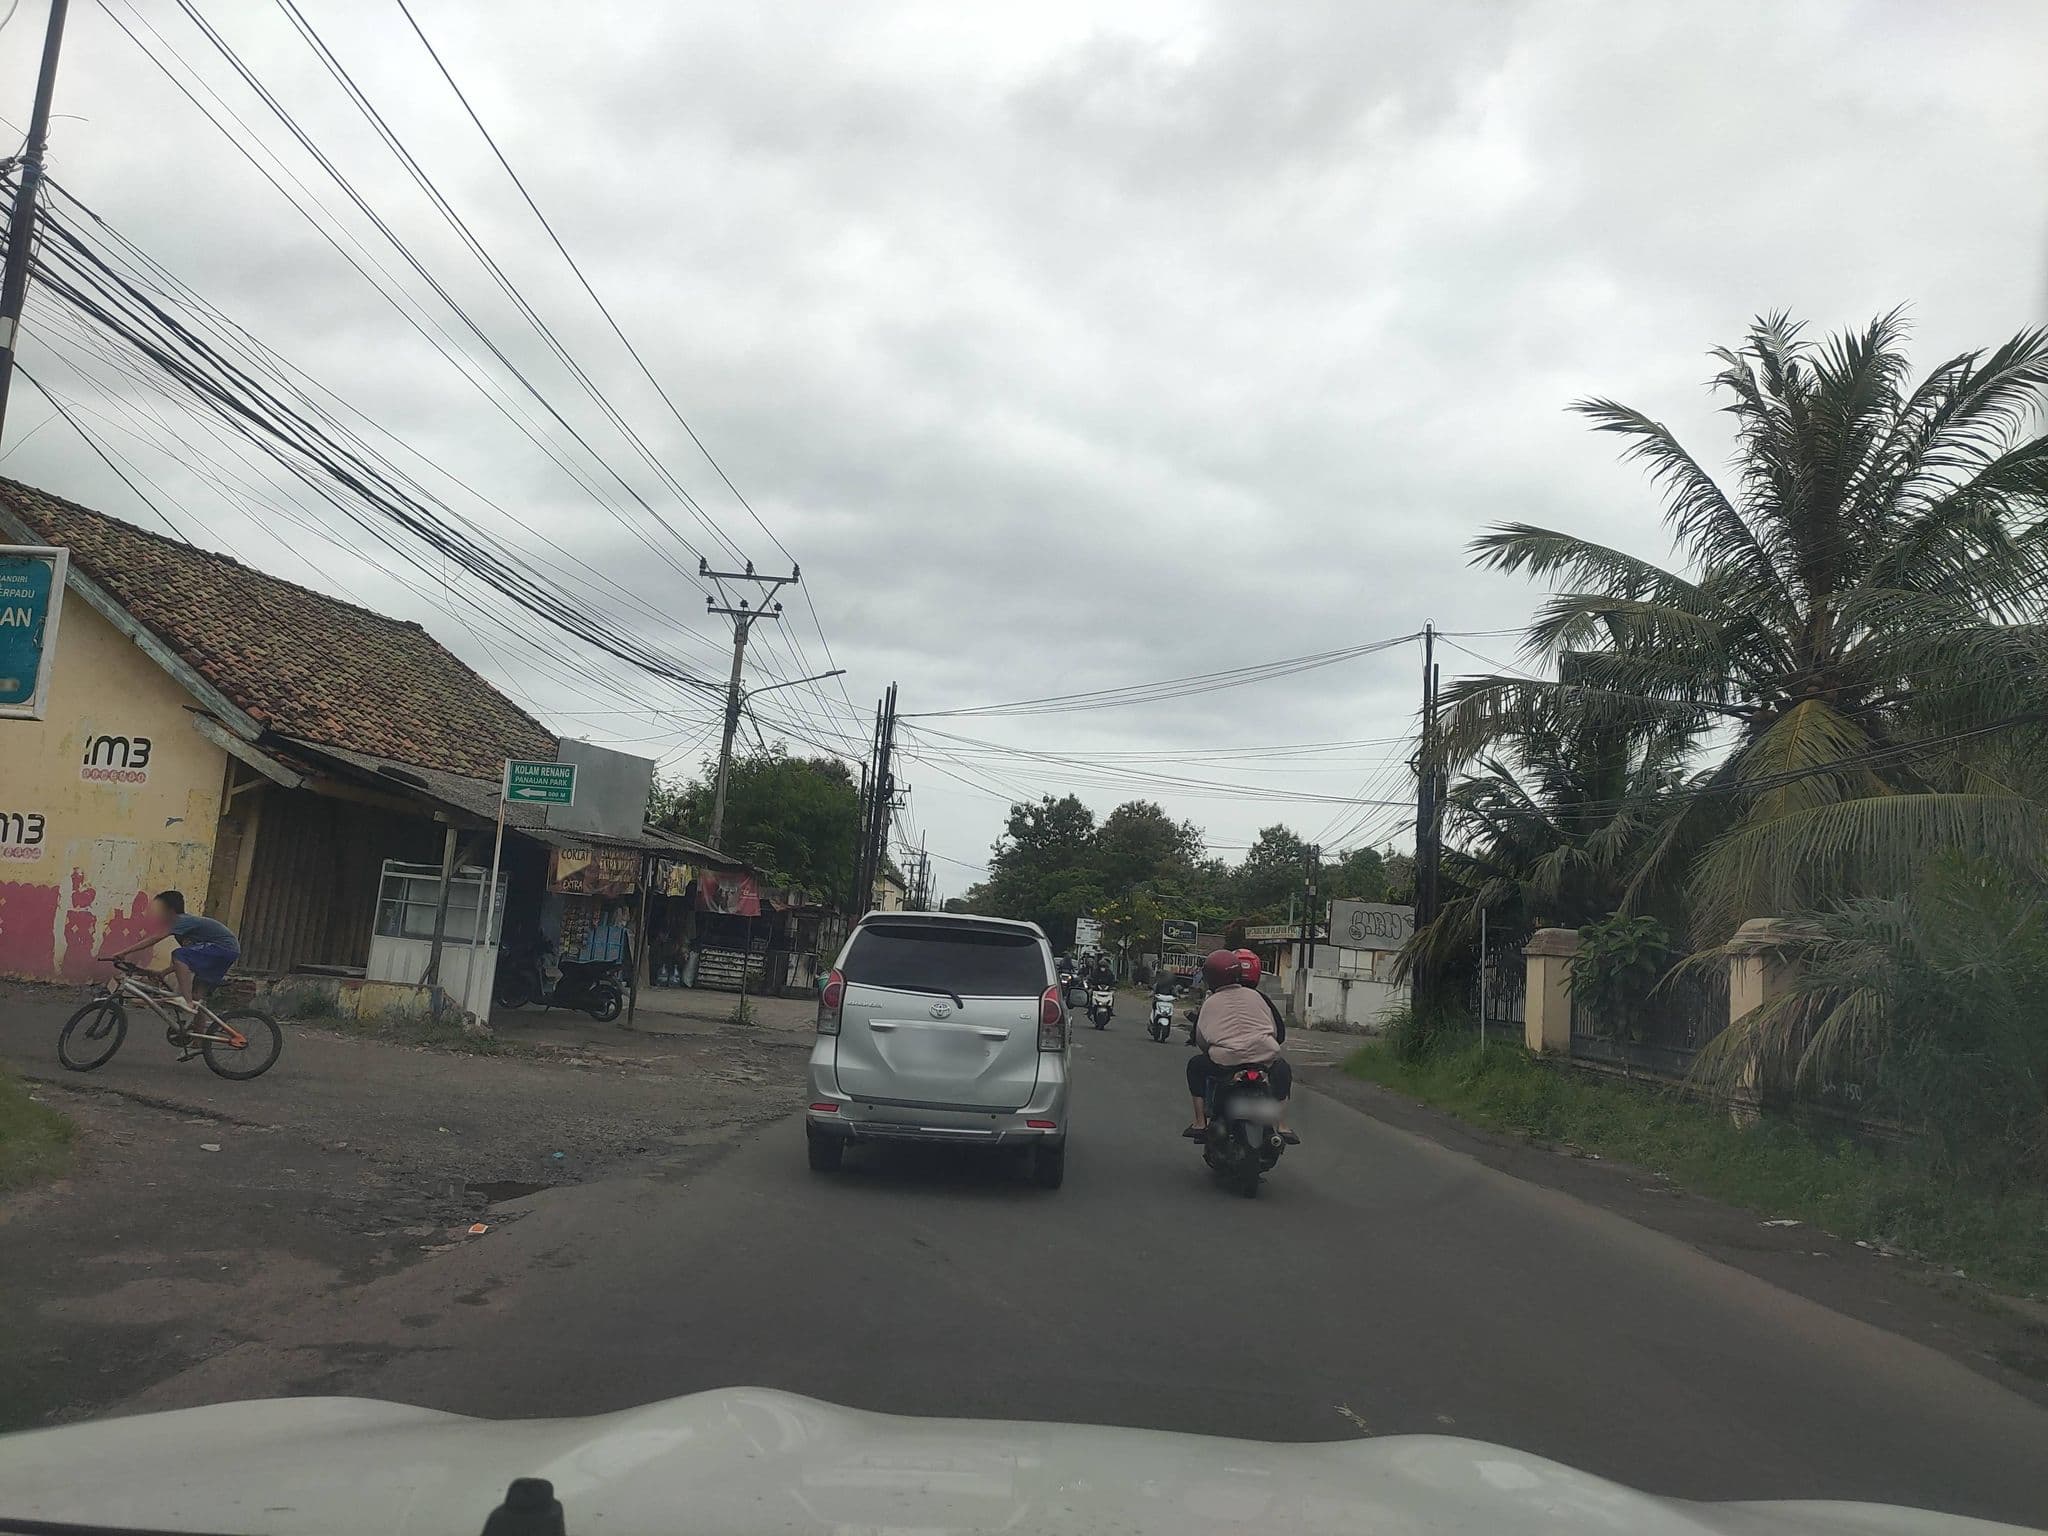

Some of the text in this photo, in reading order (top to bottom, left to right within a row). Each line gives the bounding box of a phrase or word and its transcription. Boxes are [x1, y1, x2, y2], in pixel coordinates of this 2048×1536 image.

[0, 575, 28, 583] ANDIRI
[0, 607, 32, 628] AN
[514, 765, 570, 778] KOLAM RENANG
